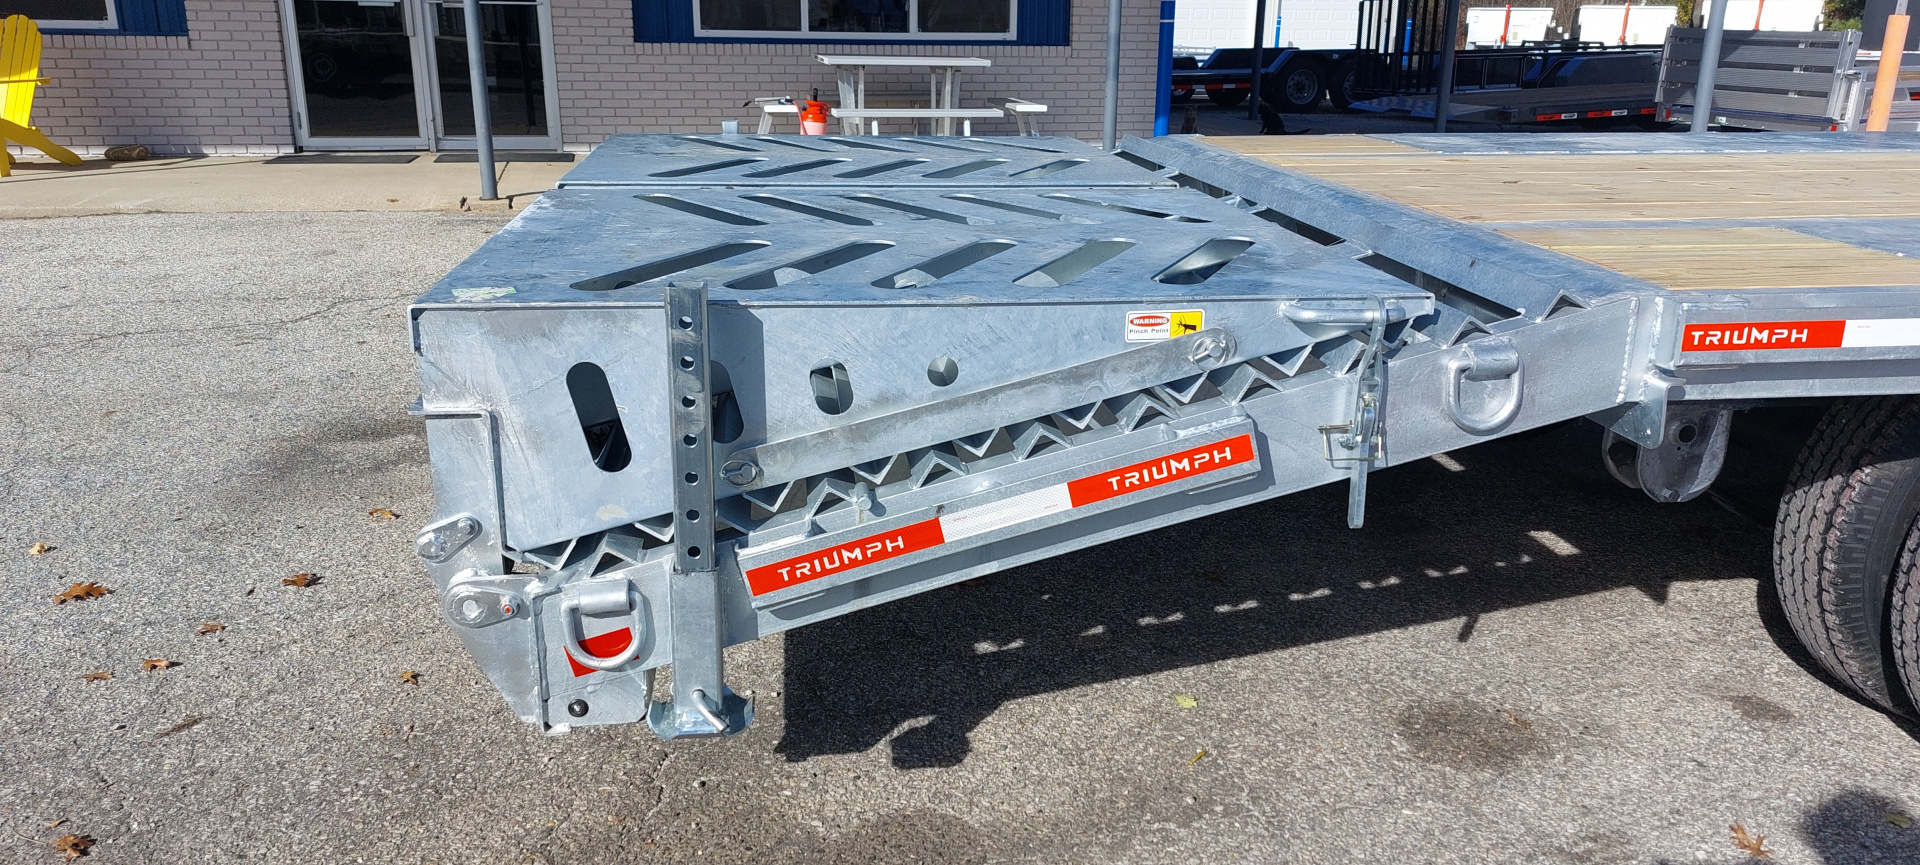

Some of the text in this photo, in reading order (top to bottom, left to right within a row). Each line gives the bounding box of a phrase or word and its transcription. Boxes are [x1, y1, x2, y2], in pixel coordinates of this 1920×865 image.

[1691, 326, 1808, 346] TRIUMPH
[1107, 446, 1232, 491] TRIUMPH
[777, 535, 905, 582] TRIUMPH
